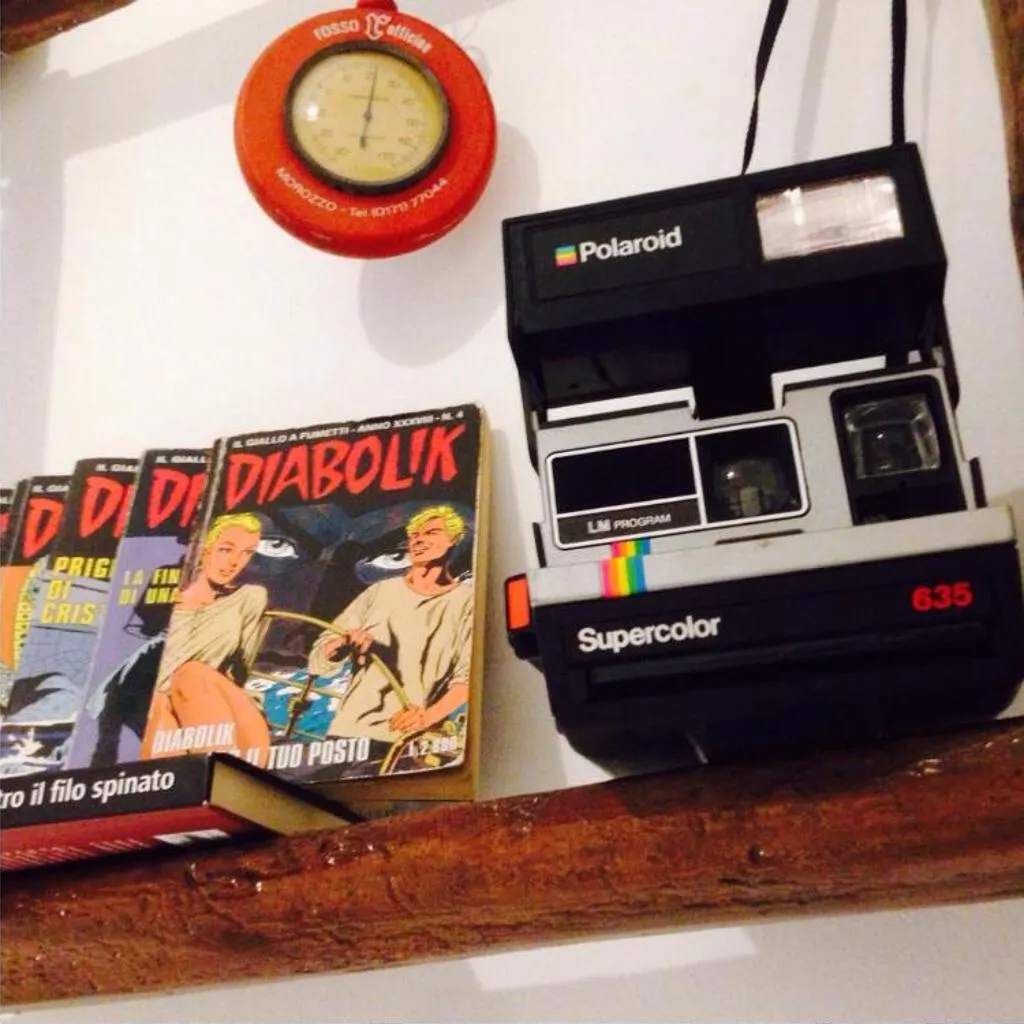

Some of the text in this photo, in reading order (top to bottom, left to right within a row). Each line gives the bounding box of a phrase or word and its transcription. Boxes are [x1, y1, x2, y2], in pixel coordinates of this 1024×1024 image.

[276, 167, 337, 212] MOROZZO
[579, 226, 682, 263] Polaroid
[245, 434, 288, 447] GIALLO
[288, 432, 297, 442] A
[299, 427, 349, 441] FUMETTI
[357, 421, 389, 433] ANNO
[225, 424, 466, 511] DIABOLIK
[614, 513, 672, 529] PROGRAM
[577, 581, 974, 653] Supercolor 635
[152, 721, 236, 756] DIABOLIK
[267, 742, 306, 770] TUO
[308, 738, 370, 766] POSTO
[30, 781, 46, 806] il
[49, 778, 85, 803] filo
[91, 769, 175, 804] spinato
